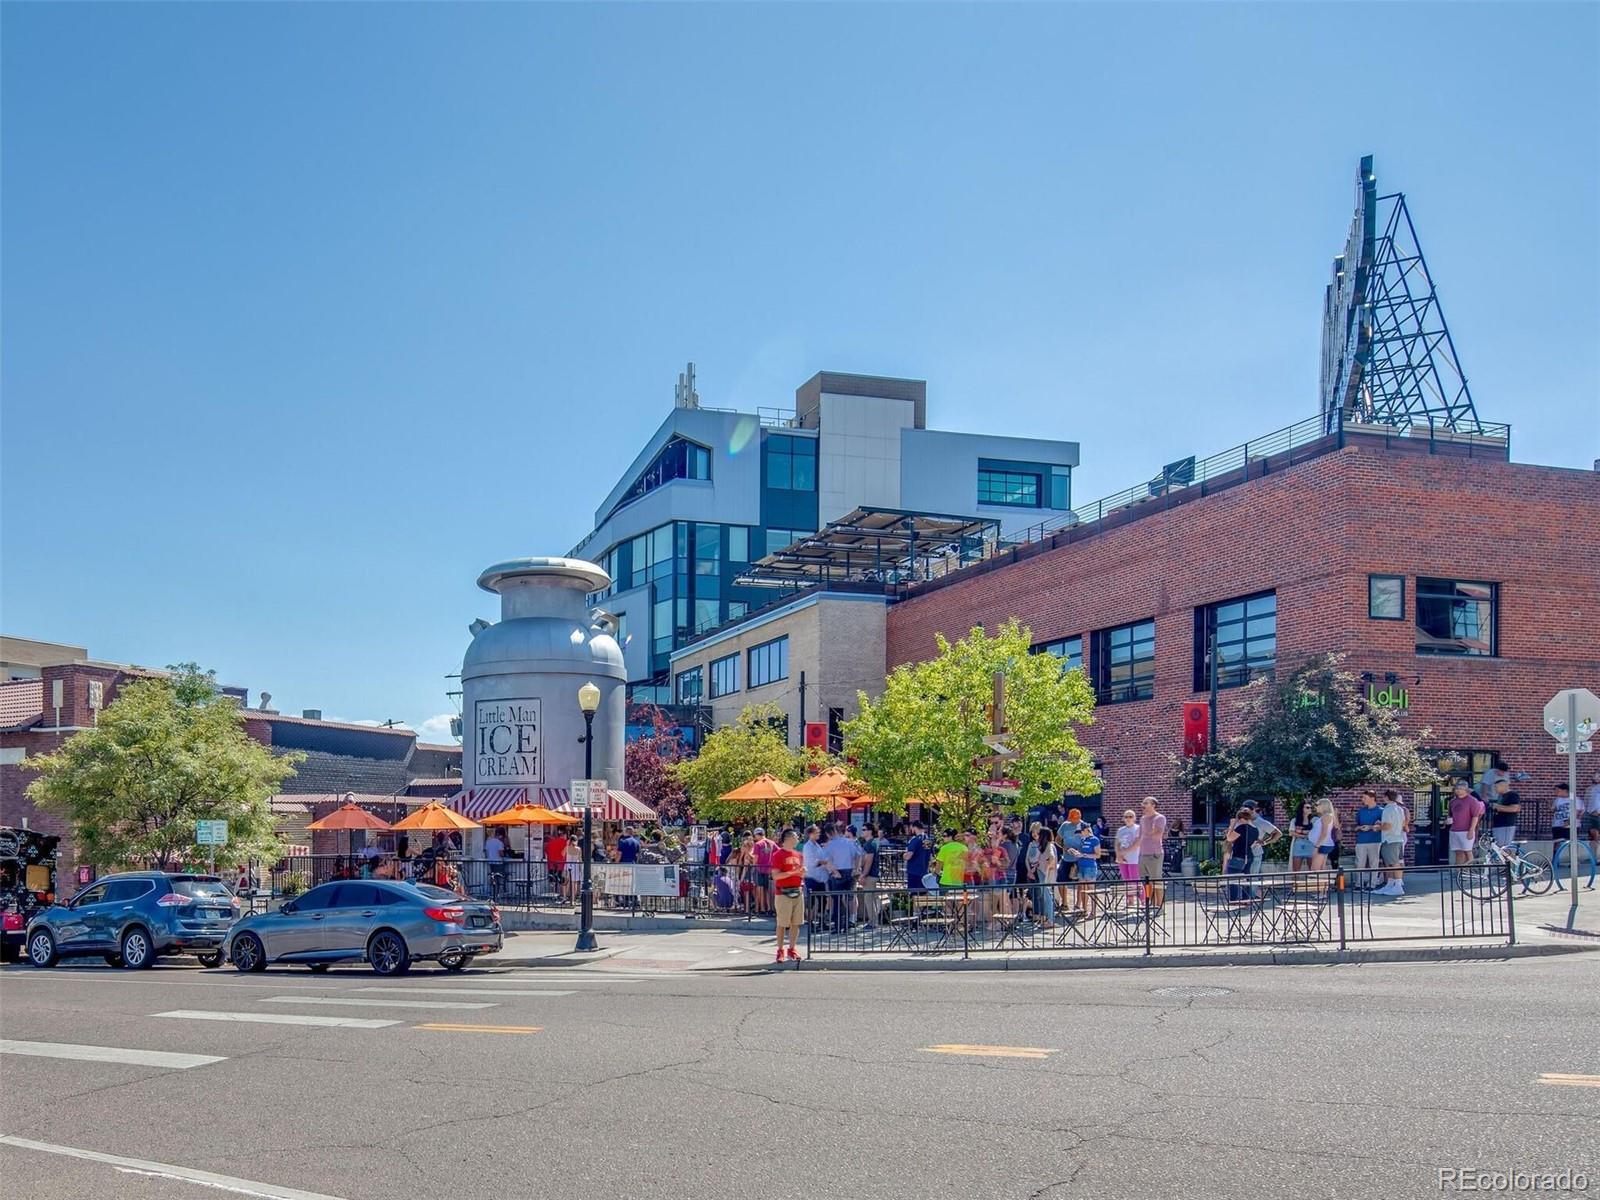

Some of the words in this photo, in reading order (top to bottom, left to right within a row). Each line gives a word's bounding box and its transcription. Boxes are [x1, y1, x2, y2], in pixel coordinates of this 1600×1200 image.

[479, 705, 505, 724] Little
[508, 705, 537, 722] Man
[479, 724, 537, 755] ICE
[478, 756, 537, 776] CREAM
